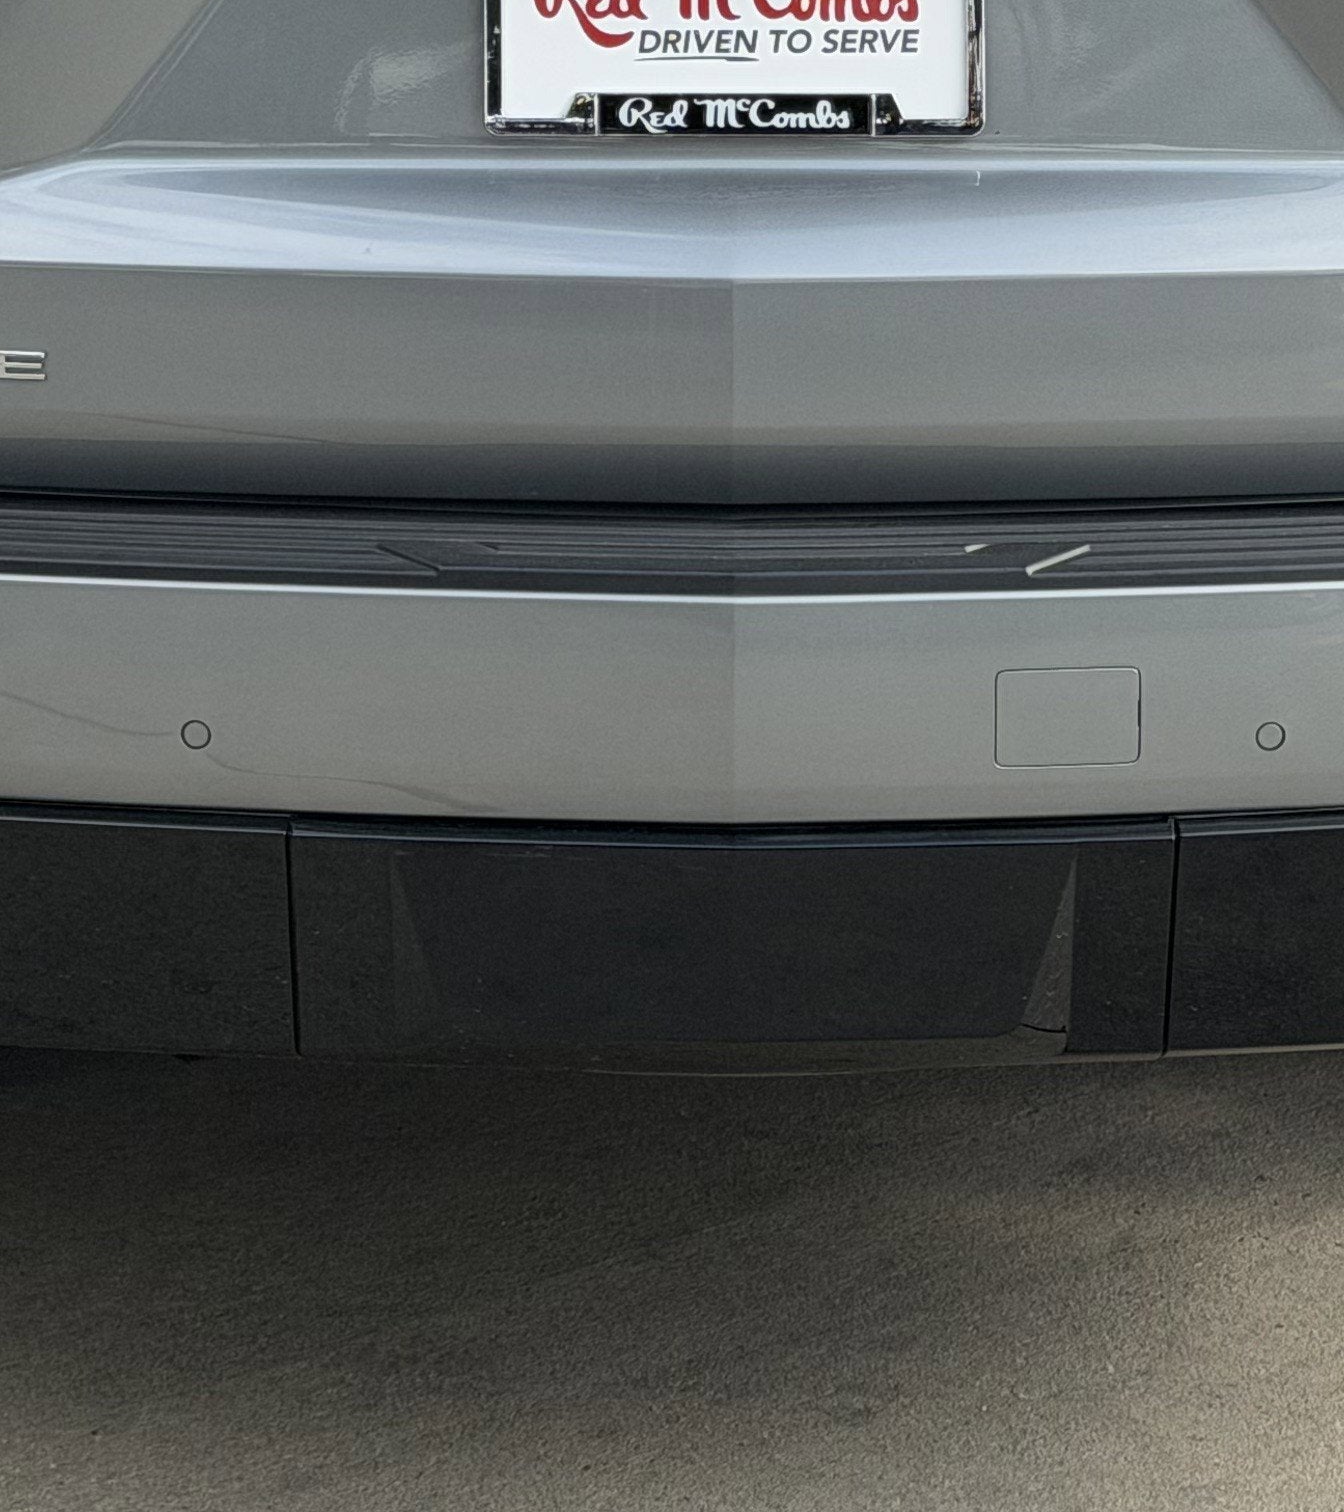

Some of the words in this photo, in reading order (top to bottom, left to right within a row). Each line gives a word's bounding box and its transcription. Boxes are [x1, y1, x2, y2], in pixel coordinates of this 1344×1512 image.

[638, 29, 759, 54] DRIVEN
[770, 28, 813, 54] TO
[821, 28, 920, 54] SERVE
[618, 96, 688, 134] Red
[694, 98, 852, 129] McCombs
